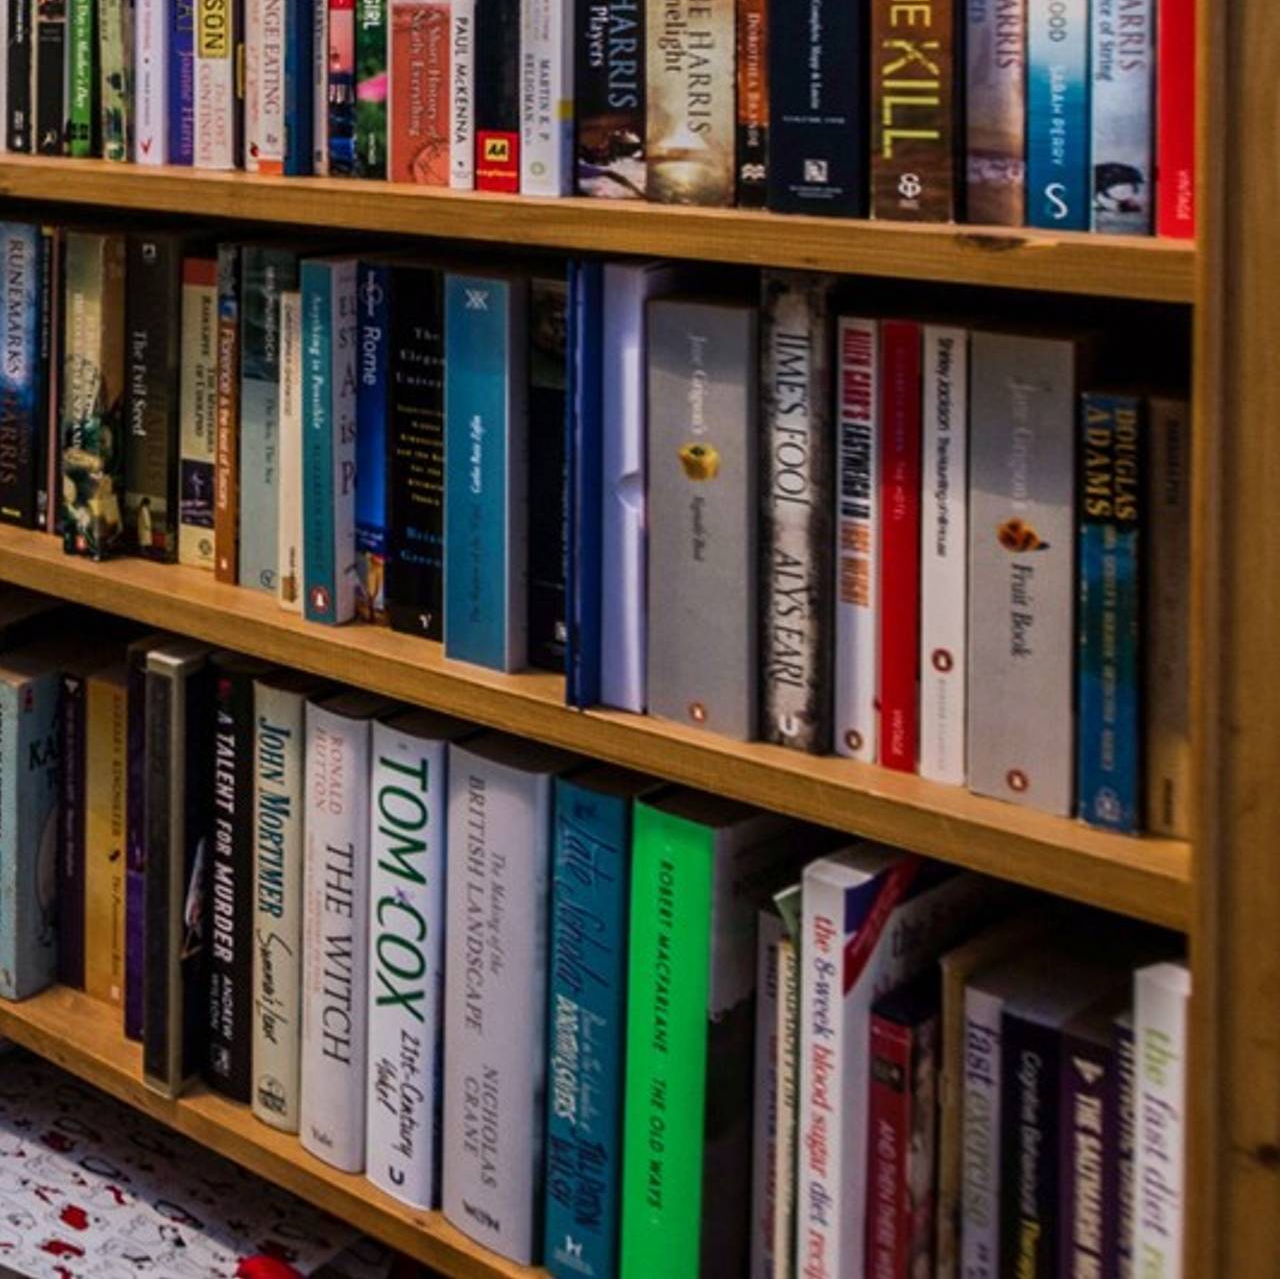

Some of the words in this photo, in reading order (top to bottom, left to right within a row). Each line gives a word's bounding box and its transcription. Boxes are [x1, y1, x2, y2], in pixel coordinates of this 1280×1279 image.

[455, 16, 469, 57] PAUL
[589, 4, 609, 67] Players
[262, 43, 280, 115] EATING
[455, 63, 468, 145] McKENNA
[688, 30, 715, 135] HARRIS
[881, 40, 940, 159] KILL
[6, 239, 24, 375] RUNEMARKS
[220, 327, 235, 394] Florence
[362, 325, 381, 386] Rome
[774, 332, 813, 419] TIME'S
[842, 328, 868, 367] ALLEN
[842, 371, 869, 421] CARR'S
[774, 426, 813, 508] FOOL
[841, 422, 870, 499] EASYWEIGH
[1087, 406, 1111, 516] ADAMS
[1113, 409, 1139, 521] DOUGLAS
[841, 520, 870, 554] LOSE
[774, 547, 811, 622] ALYS
[841, 556, 870, 608] WEIGHT
[1010, 562, 1035, 606] Fruit
[772, 624, 807, 690] EARL
[1010, 611, 1034, 659] Book
[214, 732, 236, 812] TALENT
[258, 717, 292, 786] JOHN
[313, 726, 329, 811] HUTTON
[329, 734, 345, 816] RONALD
[215, 819, 234, 854] FOR
[258, 789, 291, 919] MORTIMER
[378, 754, 430, 886] TOM
[465, 774, 488, 876] BRITISH
[212, 861, 234, 963] MURDER
[324, 840, 354, 919] THE
[658, 859, 675, 928] ROBERT
[375, 893, 429, 1025] COX
[464, 880, 486, 1036] LANDSCAPE
[814, 914, 840, 954] the
[220, 973, 234, 1039] ANDREW
[321, 933, 353, 1066] WITCH
[652, 932, 673, 1054] MACFARLANE
[811, 957, 838, 1037] 8-week
[811, 1043, 838, 1116] blood
[1145, 1026, 1178, 1085] the
[463, 1075, 481, 1155] CRANE
[479, 1064, 500, 1189] NICHOLAS
[650, 1076, 668, 1111] THE
[1140, 1090, 1178, 1160] fast
[649, 1114, 667, 1153] OLD
[804, 1117, 829, 1178] sugar
[646, 1158, 665, 1209] WAYS
[810, 1182, 835, 1226] diet
[1144, 1166, 1178, 1236] diet
